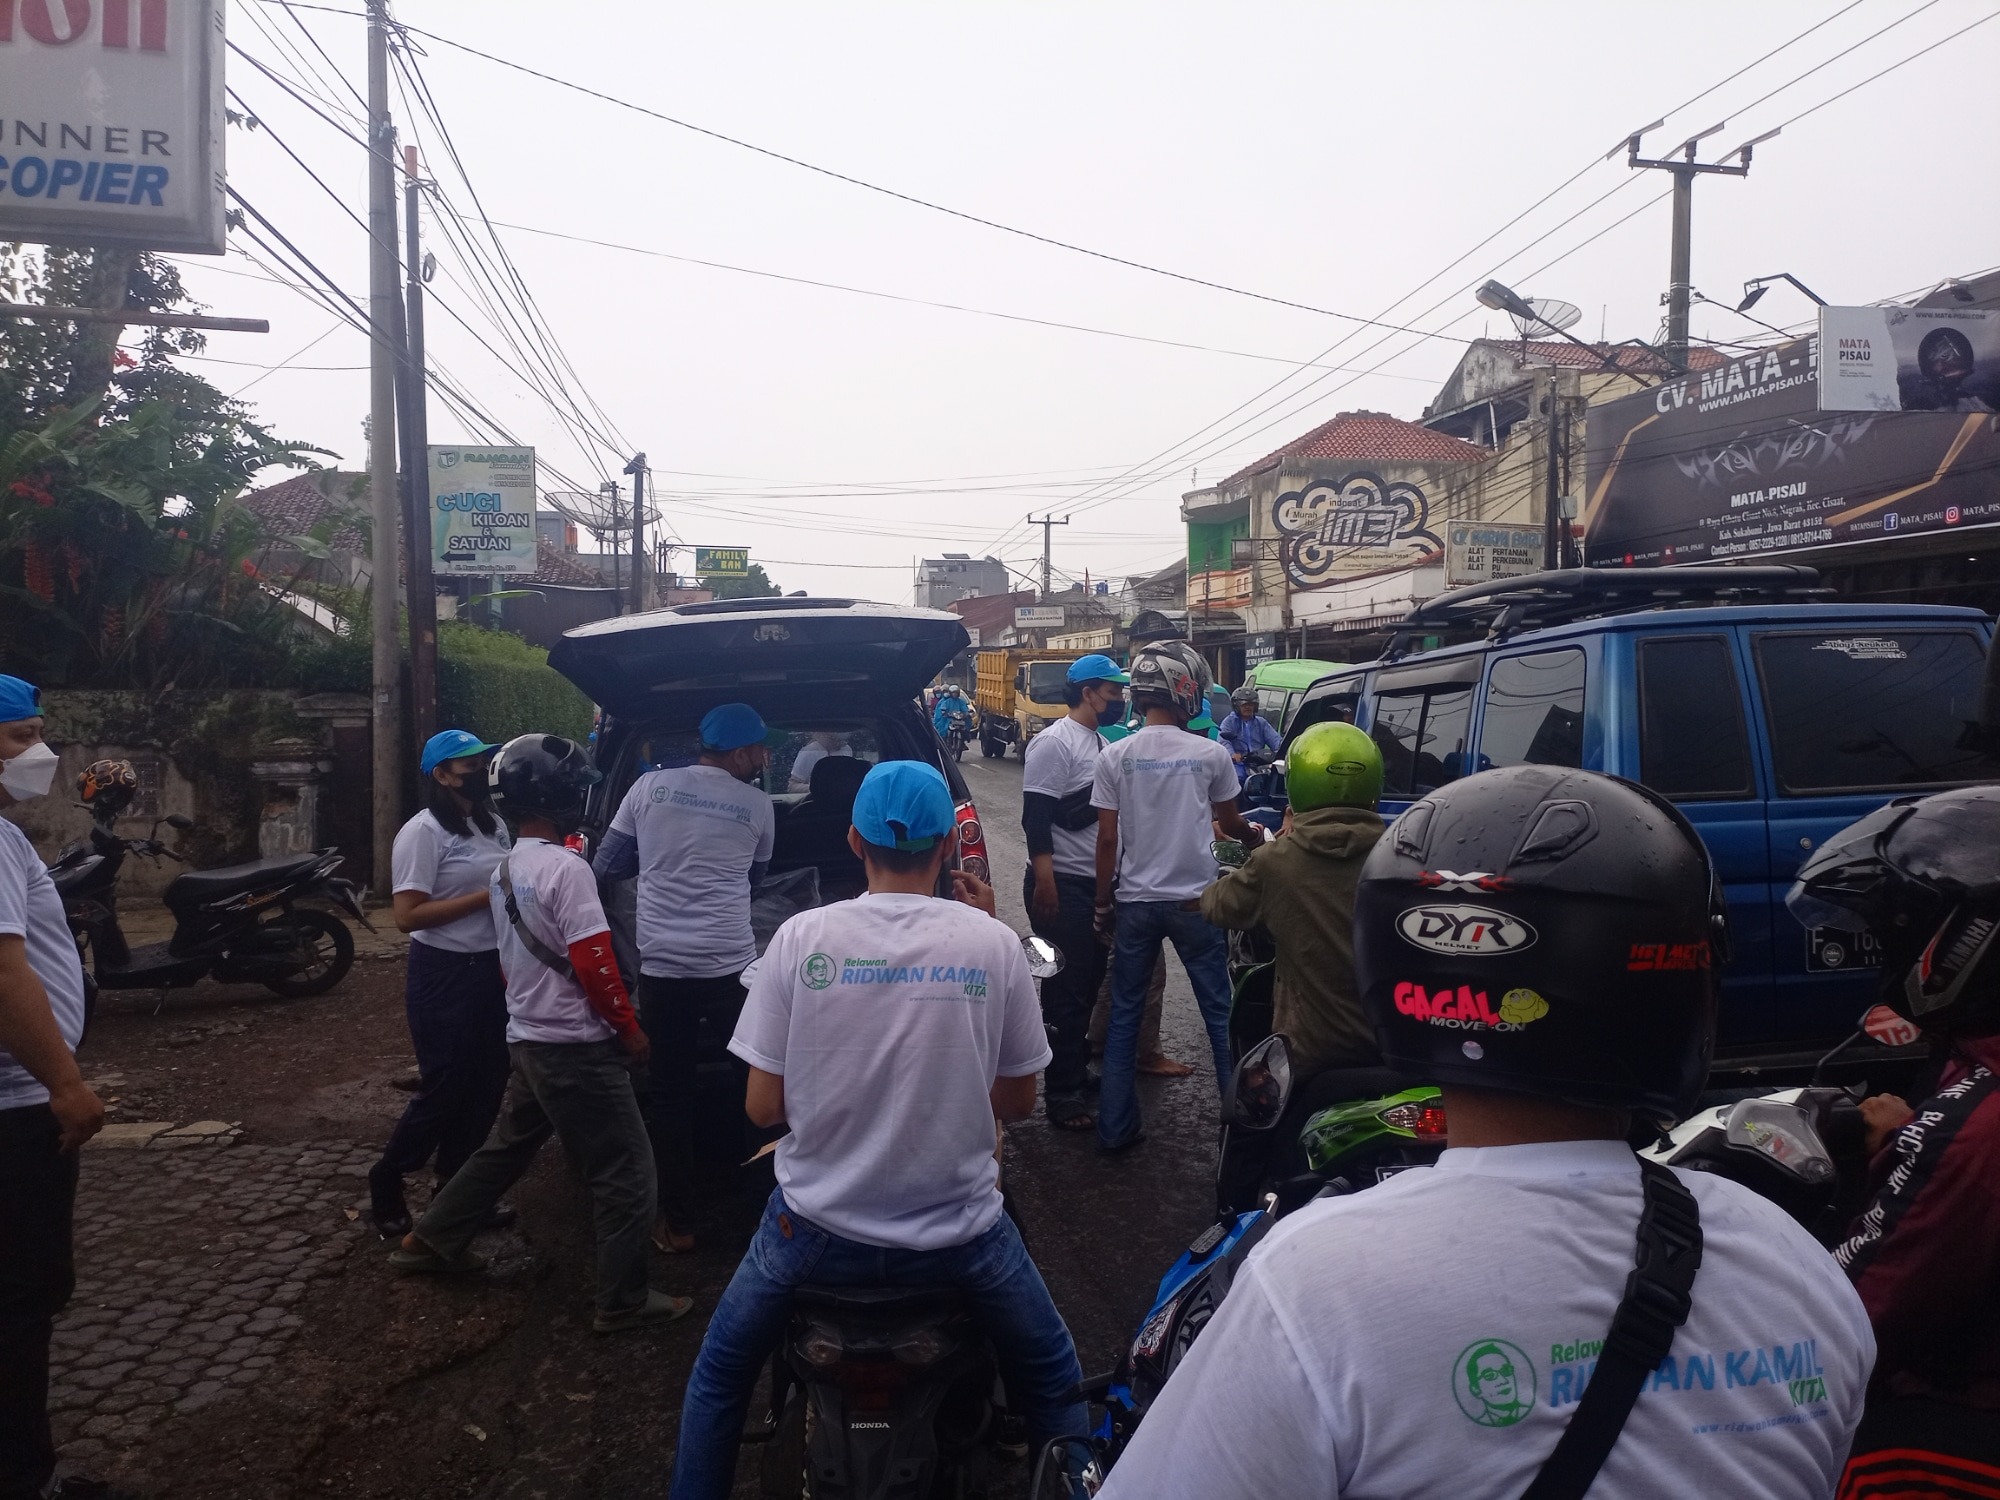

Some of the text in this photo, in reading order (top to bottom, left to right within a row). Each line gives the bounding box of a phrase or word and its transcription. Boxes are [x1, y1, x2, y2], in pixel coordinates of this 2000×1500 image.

[0, 119, 171, 156] NNER
[1839, 338, 1871, 349] MATA
[1839, 351, 1871, 361] PISAU
[1656, 380, 1694, 413] CV.
[1701, 351, 1783, 400] MATA
[464, 453, 530, 463] RAMDAN
[436, 492, 502, 513] CUCI
[1329, 498, 1361, 507] indosat
[1963, 503, 2000, 516] MATA_PIS
[472, 512, 530, 528] KILOAN
[1292, 511, 1318, 519] Murah
[482, 527, 492, 536] &
[1733, 525, 1763, 538] Sukabumi
[1767, 522, 1783, 533] Jawa
[1783, 519, 1801, 530] Barat
[449, 535, 511, 550] SATUAN
[1470, 529, 1510, 547] KARYA
[709, 550, 747, 560] FAMILY
[1468, 547, 1528, 557] ALAT PERTANIAN
[1711, 543, 1730, 556] Contact
[1730, 541, 1746, 553] Person
[720, 560, 741, 569] BAN
[1467, 555, 1534, 565] ALAT PERKEBUNAN
[1467, 563, 1485, 571] ALAT
[1167, 668, 1183, 677] KYT
[1135, 759, 1203, 771] RIDWAN KAMIL
[670, 795, 753, 818] RIDWAN KAMIL
[1416, 910, 1511, 947] DYR
[1434, 940, 1481, 951] HELMET
[1812, 927, 1824, 954] F
[1941, 917, 1994, 971] YAMAHA
[844, 957, 888, 967] Relawan
[840, 966, 988, 986] RIDWAN KAMIL
[963, 984, 987, 998] KITA
[1394, 980, 1501, 1027] GAGAL
[1429, 1016, 1487, 1032] MOVE
[1551, 1338, 1606, 1365] Relaw
[1550, 1339, 1825, 1408] RIAN KAMIL
[1788, 1376, 1829, 1408] KITA
[850, 1422, 891, 1430] HONDA
